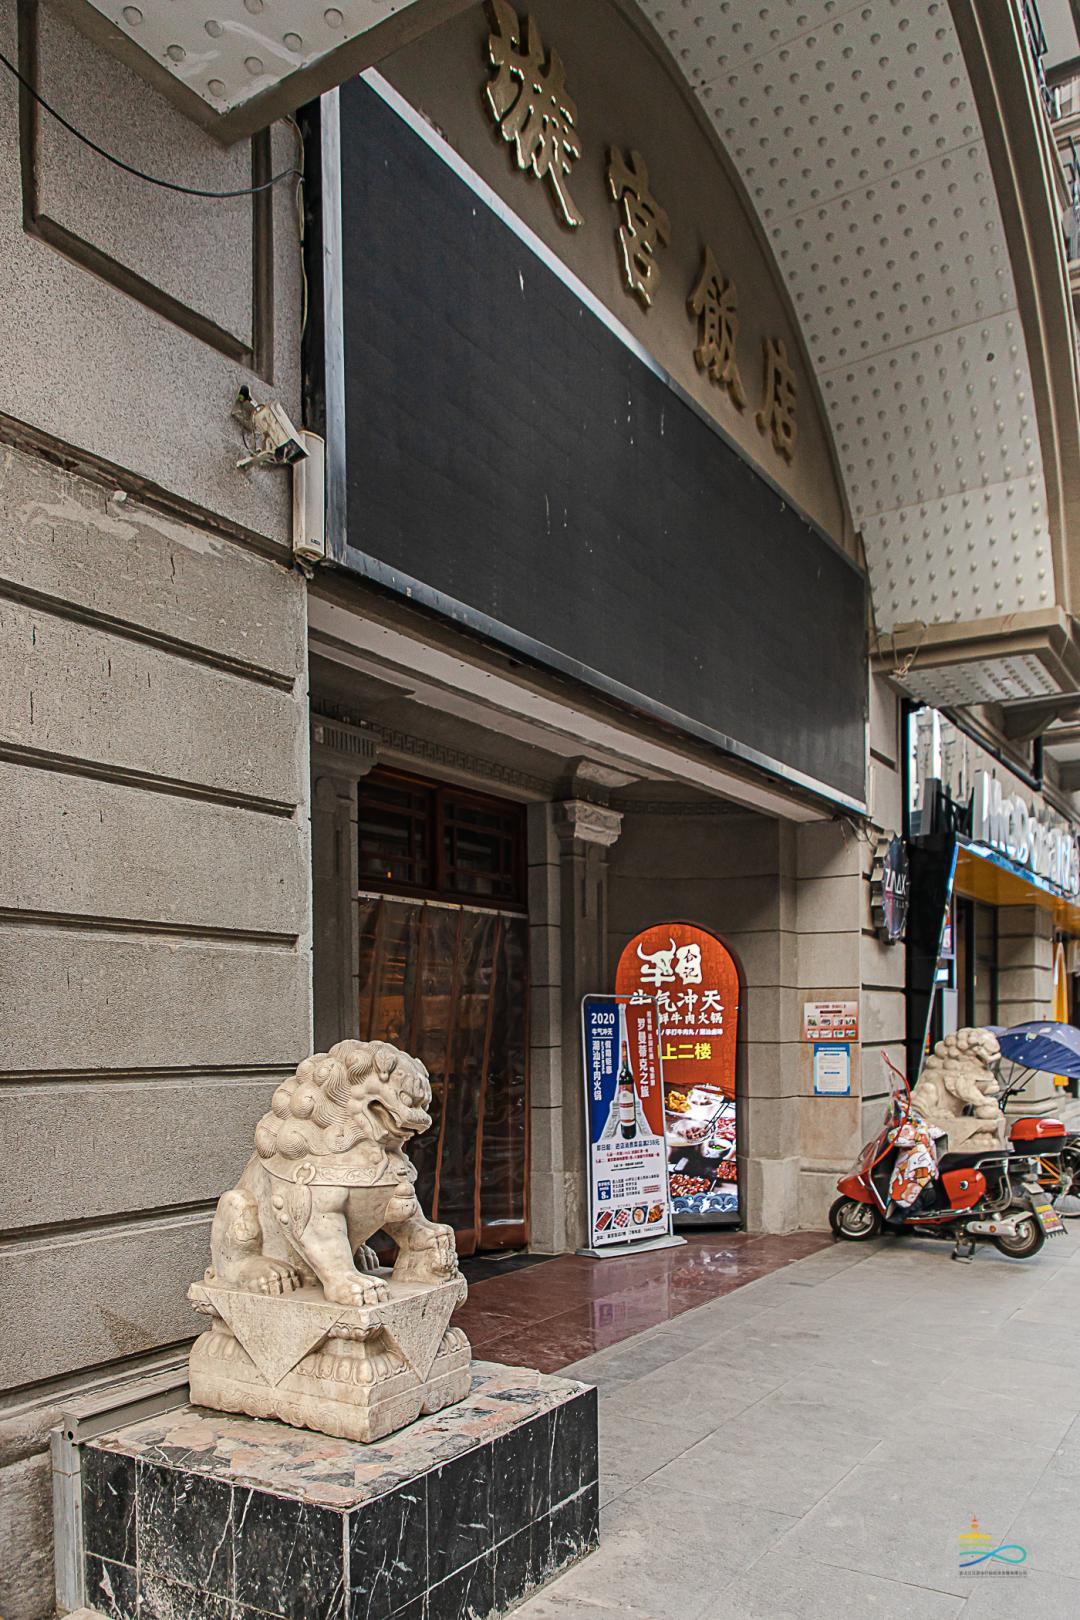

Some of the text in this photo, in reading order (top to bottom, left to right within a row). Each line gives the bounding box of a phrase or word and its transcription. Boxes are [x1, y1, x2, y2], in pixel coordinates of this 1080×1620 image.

[629, 989, 725, 1013] 牛气冲天
[591, 1012, 615, 1024] 2020
[591, 1027, 613, 1036] 牛气冲天
[637, 1018, 650, 1098] 罗曼蒂克之旅
[657, 1042, 712, 1060] 上二楼
[592, 1040, 602, 1101] 潮汕牛肉火锅
